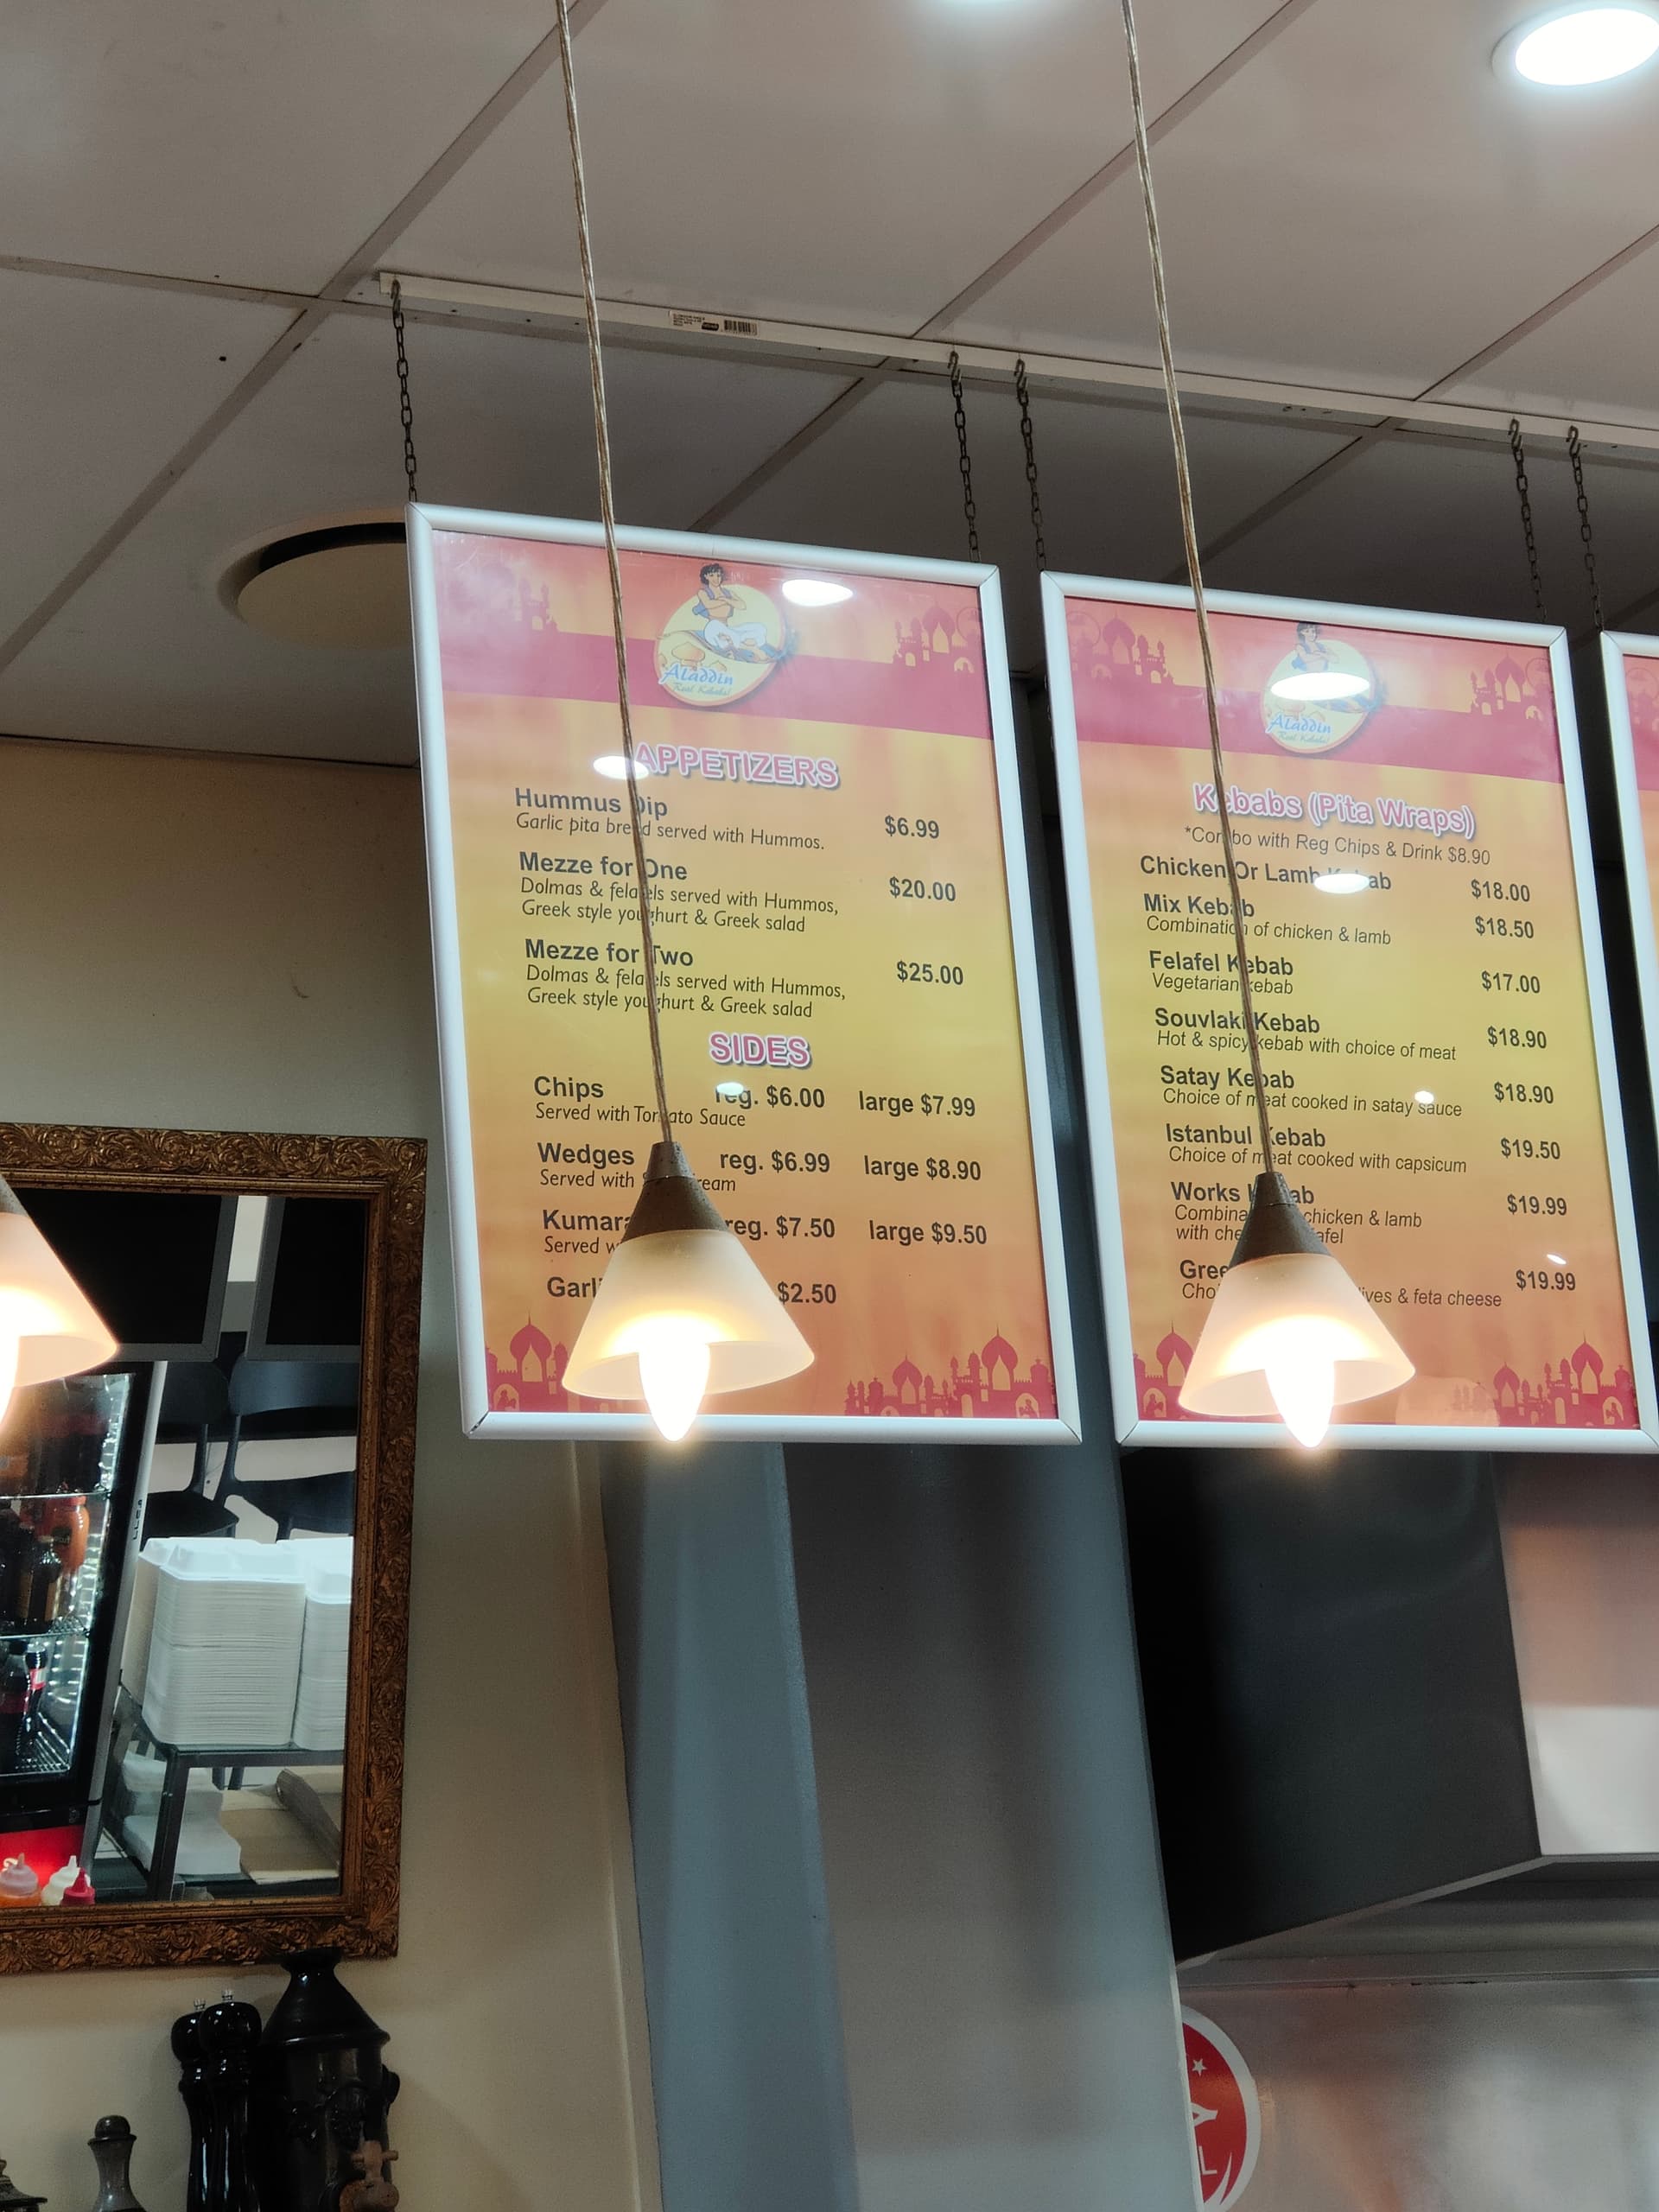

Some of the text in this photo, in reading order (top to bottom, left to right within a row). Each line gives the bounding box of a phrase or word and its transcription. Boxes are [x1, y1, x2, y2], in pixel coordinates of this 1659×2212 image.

[633, 742, 841, 788] APPETIZERS
[515, 788, 621, 813] Hummus
[884, 815, 940, 840] $6.99
[1308, 792, 1373, 825] (Pita
[1377, 798, 1475, 839] Wraps)
[517, 813, 824, 850] Garlic pita bred served with Hummos.
[1258, 831, 1290, 849] with
[1296, 835, 1329, 854] Reg
[1335, 836, 1380, 857] Chips
[1386, 842, 1397, 857] &
[1402, 843, 1442, 861] Drink
[1447, 846, 1491, 866] $8.90
[519, 851, 688, 880] Mezze for One
[1141, 855, 1227, 879] Chicken
[1234, 861, 1258, 880] Or
[1266, 864, 1320, 885] Lamb
[521, 877, 839, 914] Dolmas & felals served with Hummos,
[889, 876, 957, 902] $20.00
[1471, 879, 1530, 903] $18.00
[522, 899, 570, 917] Greek
[577, 902, 613, 923] style
[695, 910, 708, 925] &
[715, 910, 760, 929] Greek
[766, 914, 805, 932] salad
[1144, 893, 1255, 918] Mix Kebb
[1254, 921, 1271, 936] of
[1274, 924, 1333, 942] chicken
[1338, 927, 1350, 942] &
[1355, 927, 1391, 945] lamb
[1475, 916, 1535, 939] $18.50
[525, 939, 693, 966] Mezze for Two
[1150, 950, 1294, 976] Felafel Kebab
[527, 964, 845, 1001] Dolmas & felals served with Hummos,
[897, 960, 963, 987] $25.00
[1153, 972, 1238, 994] Vegetarian
[1481, 970, 1541, 995] $17.00
[528, 988, 576, 1006] Greek
[583, 989, 618, 1010] style
[702, 997, 714, 1014] &
[721, 998, 766, 1017] Greek
[772, 1001, 812, 1019] salad
[1155, 1007, 1320, 1033] Souvlaki Kebab
[709, 1033, 811, 1069] SIDES
[1158, 1030, 1456, 1061] Hot & spicy kebab with choice of meat
[1487, 1027, 1547, 1049] $18.90
[1160, 1065, 1220, 1090] Satay
[534, 1076, 605, 1101] Chips
[766, 1085, 825, 1109] $6.00
[859, 1091, 914, 1118] large
[921, 1094, 976, 1118] $7.99
[1164, 1088, 1220, 1106] Choice
[1226, 1092, 1242, 1108] of
[1292, 1093, 1348, 1112] cooked
[1354, 1098, 1367, 1112] in
[1372, 1098, 1414, 1116] satay
[1418, 1100, 1462, 1117] sauce
[1494, 1082, 1554, 1104] $18.90
[536, 1103, 590, 1122] Served
[597, 1105, 630, 1122] with
[700, 1109, 747, 1127] Sauce
[1166, 1122, 1252, 1145] Istanbul
[537, 1142, 981, 1182] Wedges reg. $6.99 large $8.90
[1169, 1146, 1226, 1165] Choice
[1231, 1150, 1249, 1165] of
[1297, 1152, 1354, 1170] cooked
[1360, 1154, 1390, 1170] with
[1395, 1157, 1466, 1176] capsicum
[1500, 1138, 1560, 1160] $19.50
[540, 1170, 595, 1188] Served
[601, 1172, 634, 1189] with
[696, 1176, 736, 1191] eam
[1171, 1181, 1241, 1204] Works
[1175, 1205, 1422, 1228] Combina chicken & lamb
[1507, 1194, 1567, 1217] $19.99
[725, 1217, 768, 1240] reg.
[776, 1216, 835, 1239] $7.50
[869, 1219, 925, 1245] large
[931, 1222, 987, 1245] $9.50
[1176, 1224, 1209, 1242] with
[1317, 1229, 1344, 1244] afel
[545, 1236, 599, 1255] Served
[1179, 1260, 1576, 1293] Gree $19.99
[547, 1276, 837, 1305] Garl $2.50
[1358, 1287, 1392, 1304] ives
[1398, 1289, 1409, 1305] &
[1414, 1290, 1442, 1306] feta
[1447, 1291, 1502, 1307] cheese
